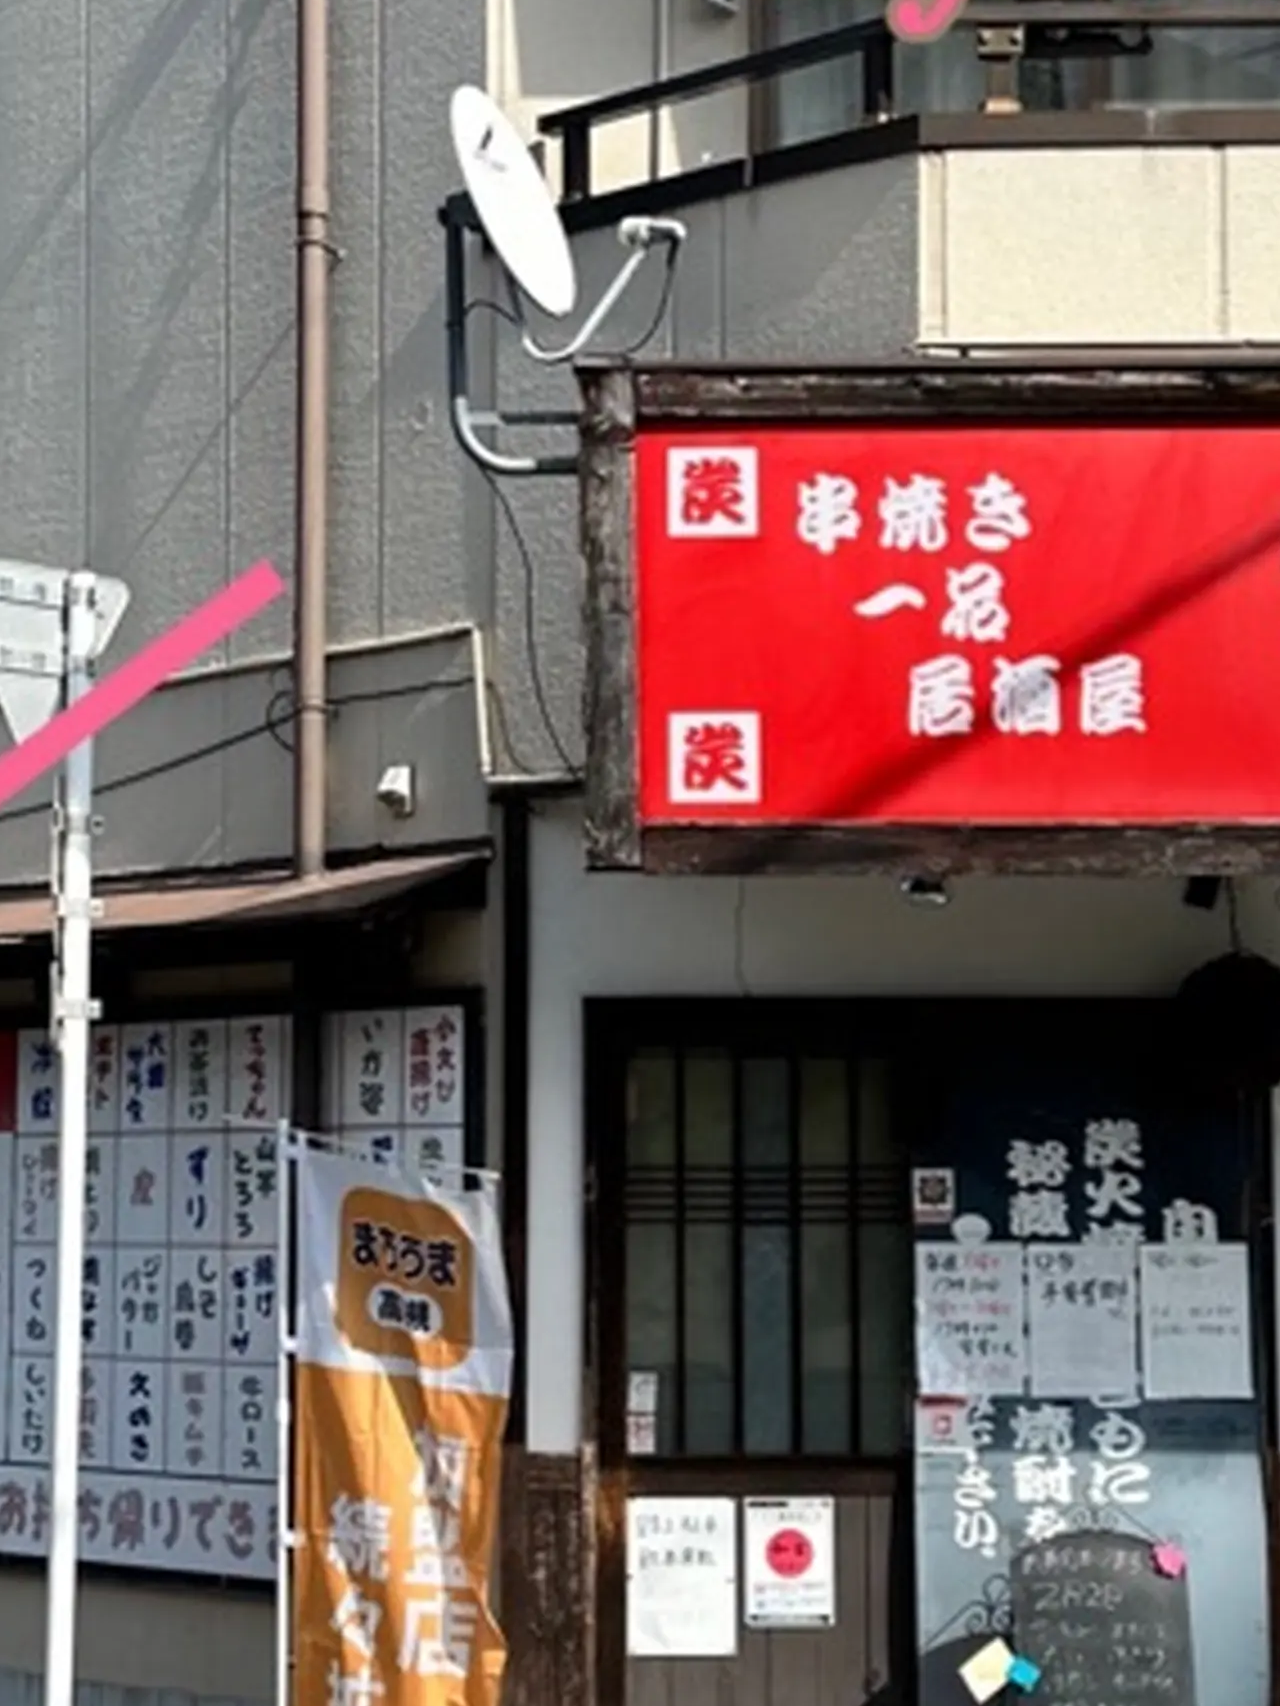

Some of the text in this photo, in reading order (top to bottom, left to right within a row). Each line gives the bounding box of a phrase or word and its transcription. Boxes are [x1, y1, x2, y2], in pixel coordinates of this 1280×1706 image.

[796, 472, 1031, 554] 串焼き
[907, 653, 1148, 736] 居酒屋
[25, 1258, 48, 1342] つくね
